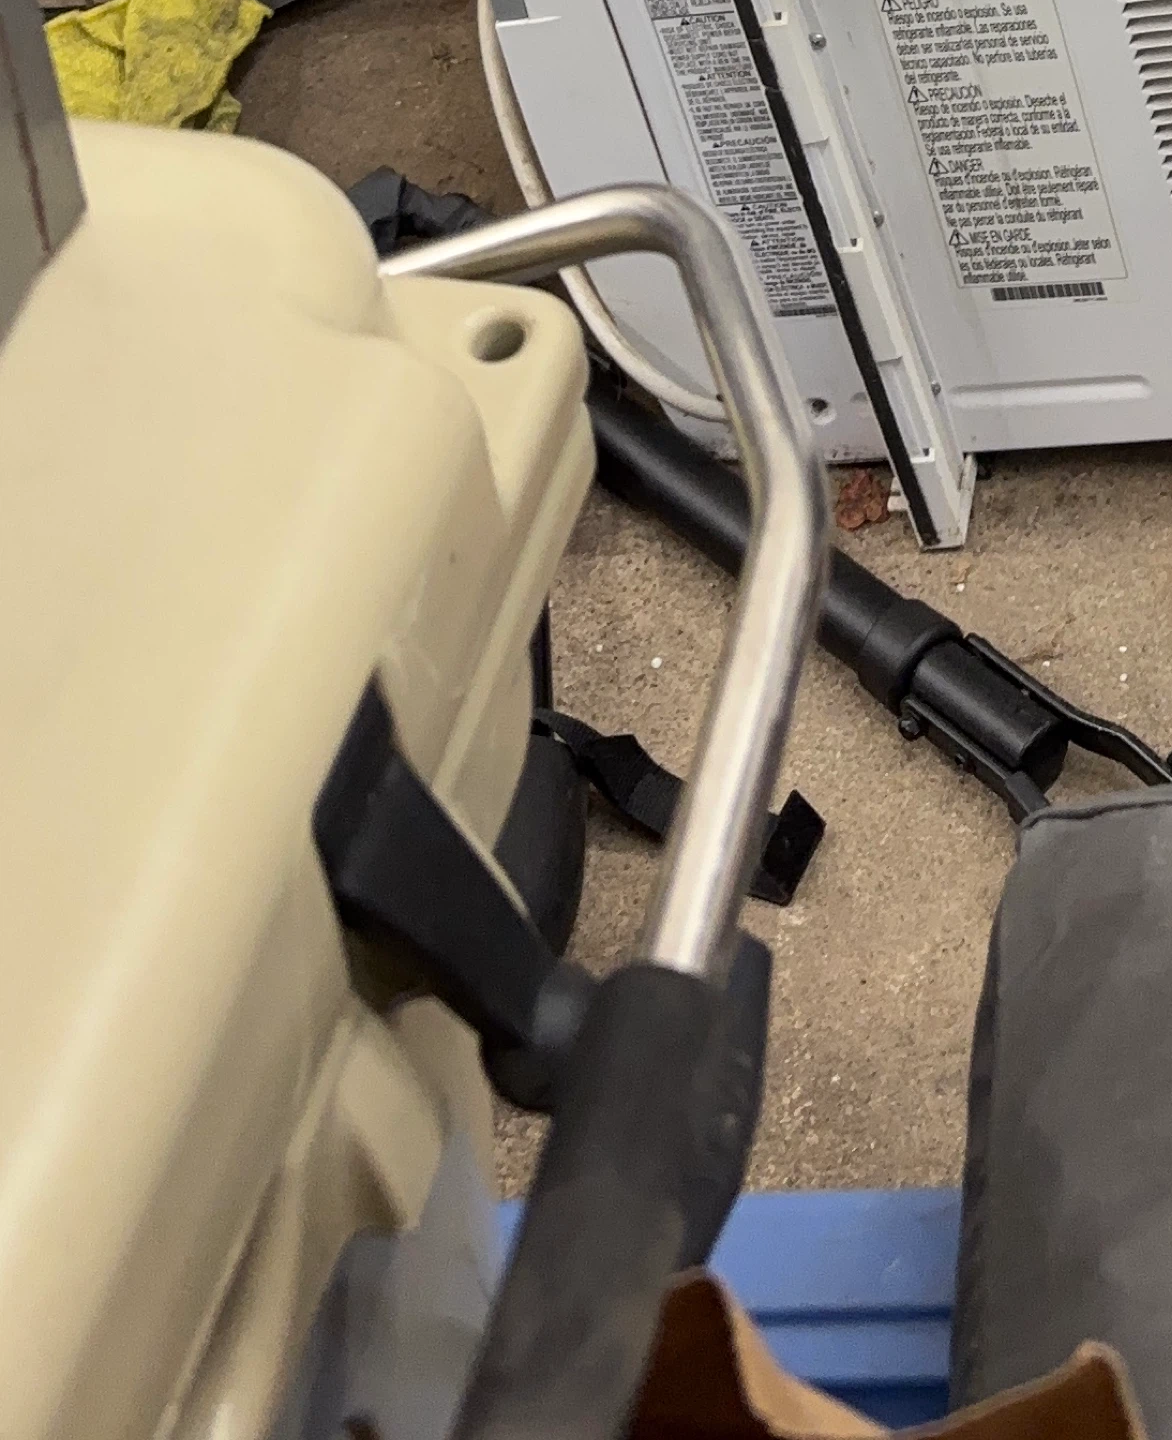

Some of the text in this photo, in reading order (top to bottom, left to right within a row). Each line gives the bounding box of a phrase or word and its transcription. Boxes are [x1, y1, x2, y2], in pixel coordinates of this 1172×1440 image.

[928, 85, 982, 101] PRECAUCIÓN
[948, 158, 982, 173] DANGER
[969, 227, 1032, 243] MISE EN GARDE
